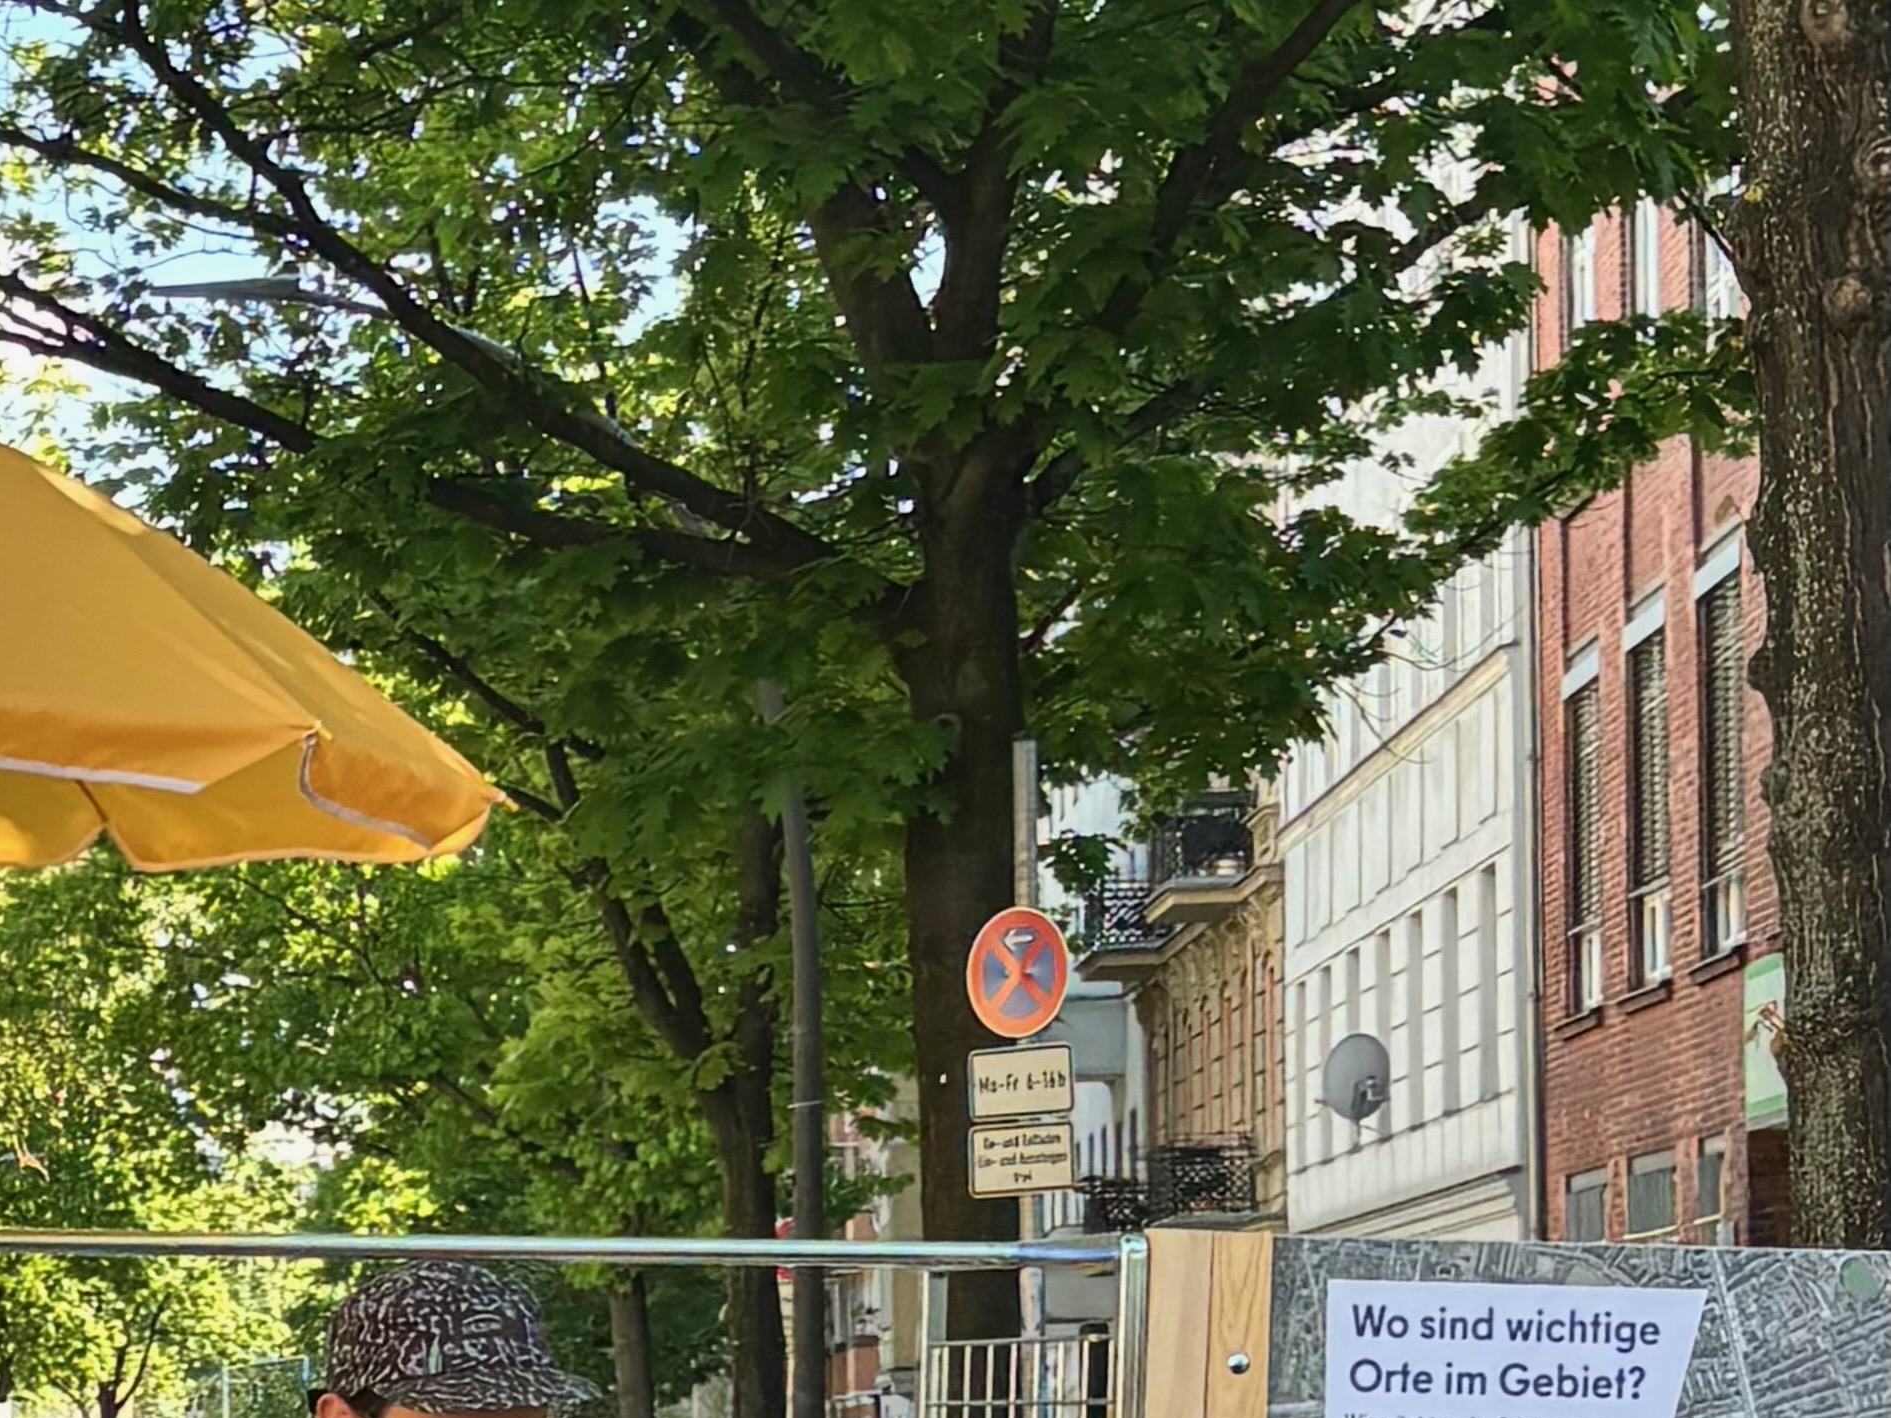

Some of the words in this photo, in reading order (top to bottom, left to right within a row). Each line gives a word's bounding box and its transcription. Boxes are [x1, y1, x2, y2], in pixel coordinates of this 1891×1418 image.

[1353, 1304, 1408, 1339] Wo
[1420, 1306, 1494, 1341] sind
[1507, 1308, 1660, 1353] wichtige
[1350, 1358, 1433, 1395] Orte
[1445, 1362, 1487, 1396] im
[1499, 1362, 1646, 1400] Gebiet?
